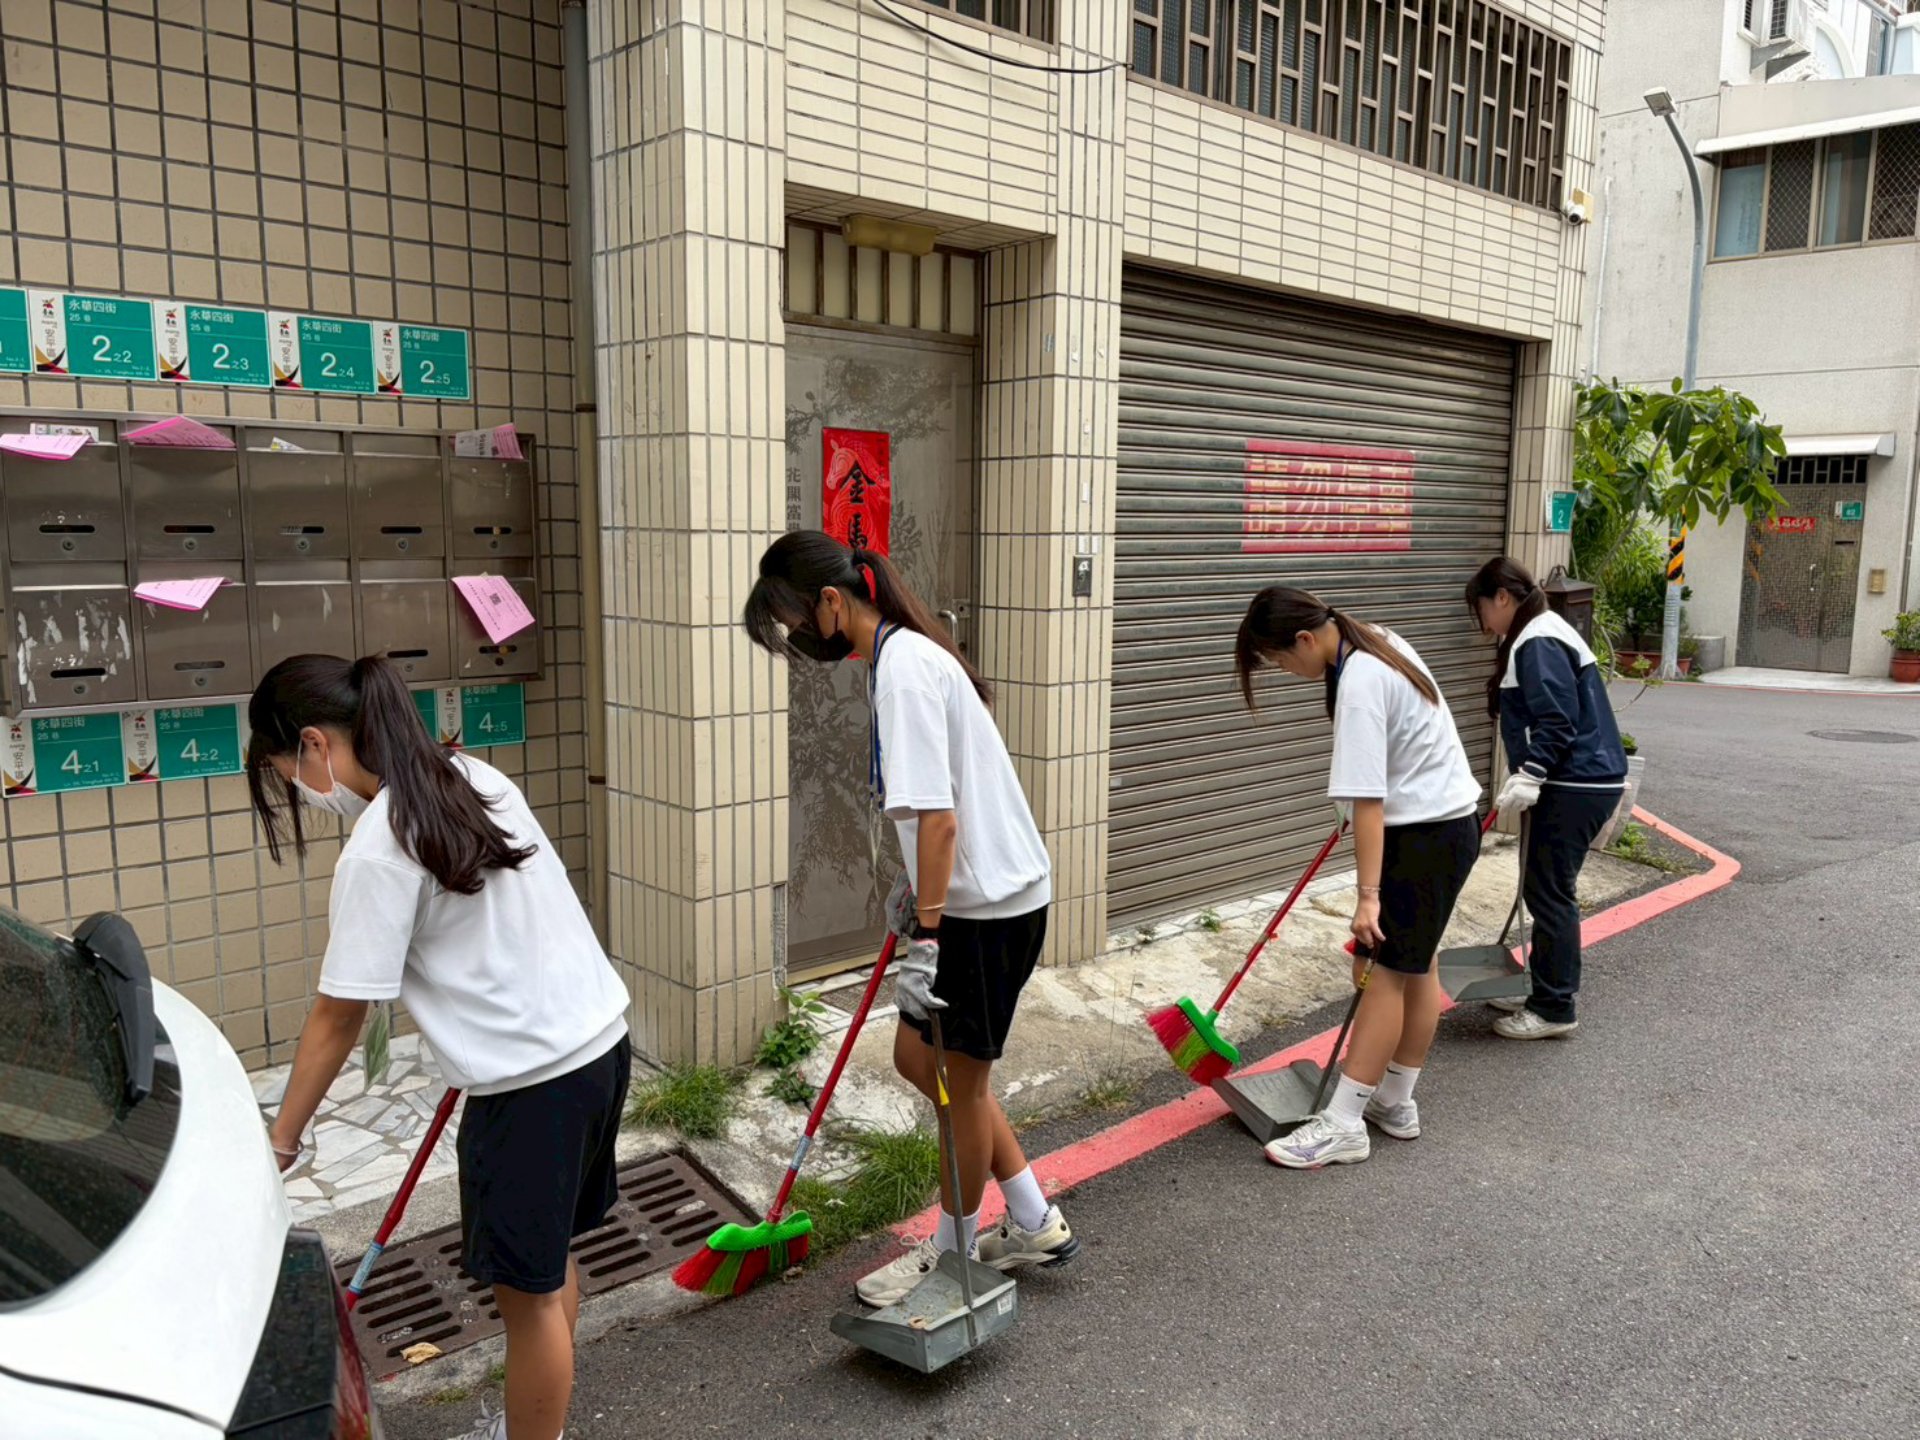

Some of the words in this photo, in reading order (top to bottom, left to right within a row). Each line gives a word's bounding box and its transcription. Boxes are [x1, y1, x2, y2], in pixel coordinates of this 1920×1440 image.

[69, 300, 117, 314] 永華四街
[190, 310, 234, 323] 永華四街
